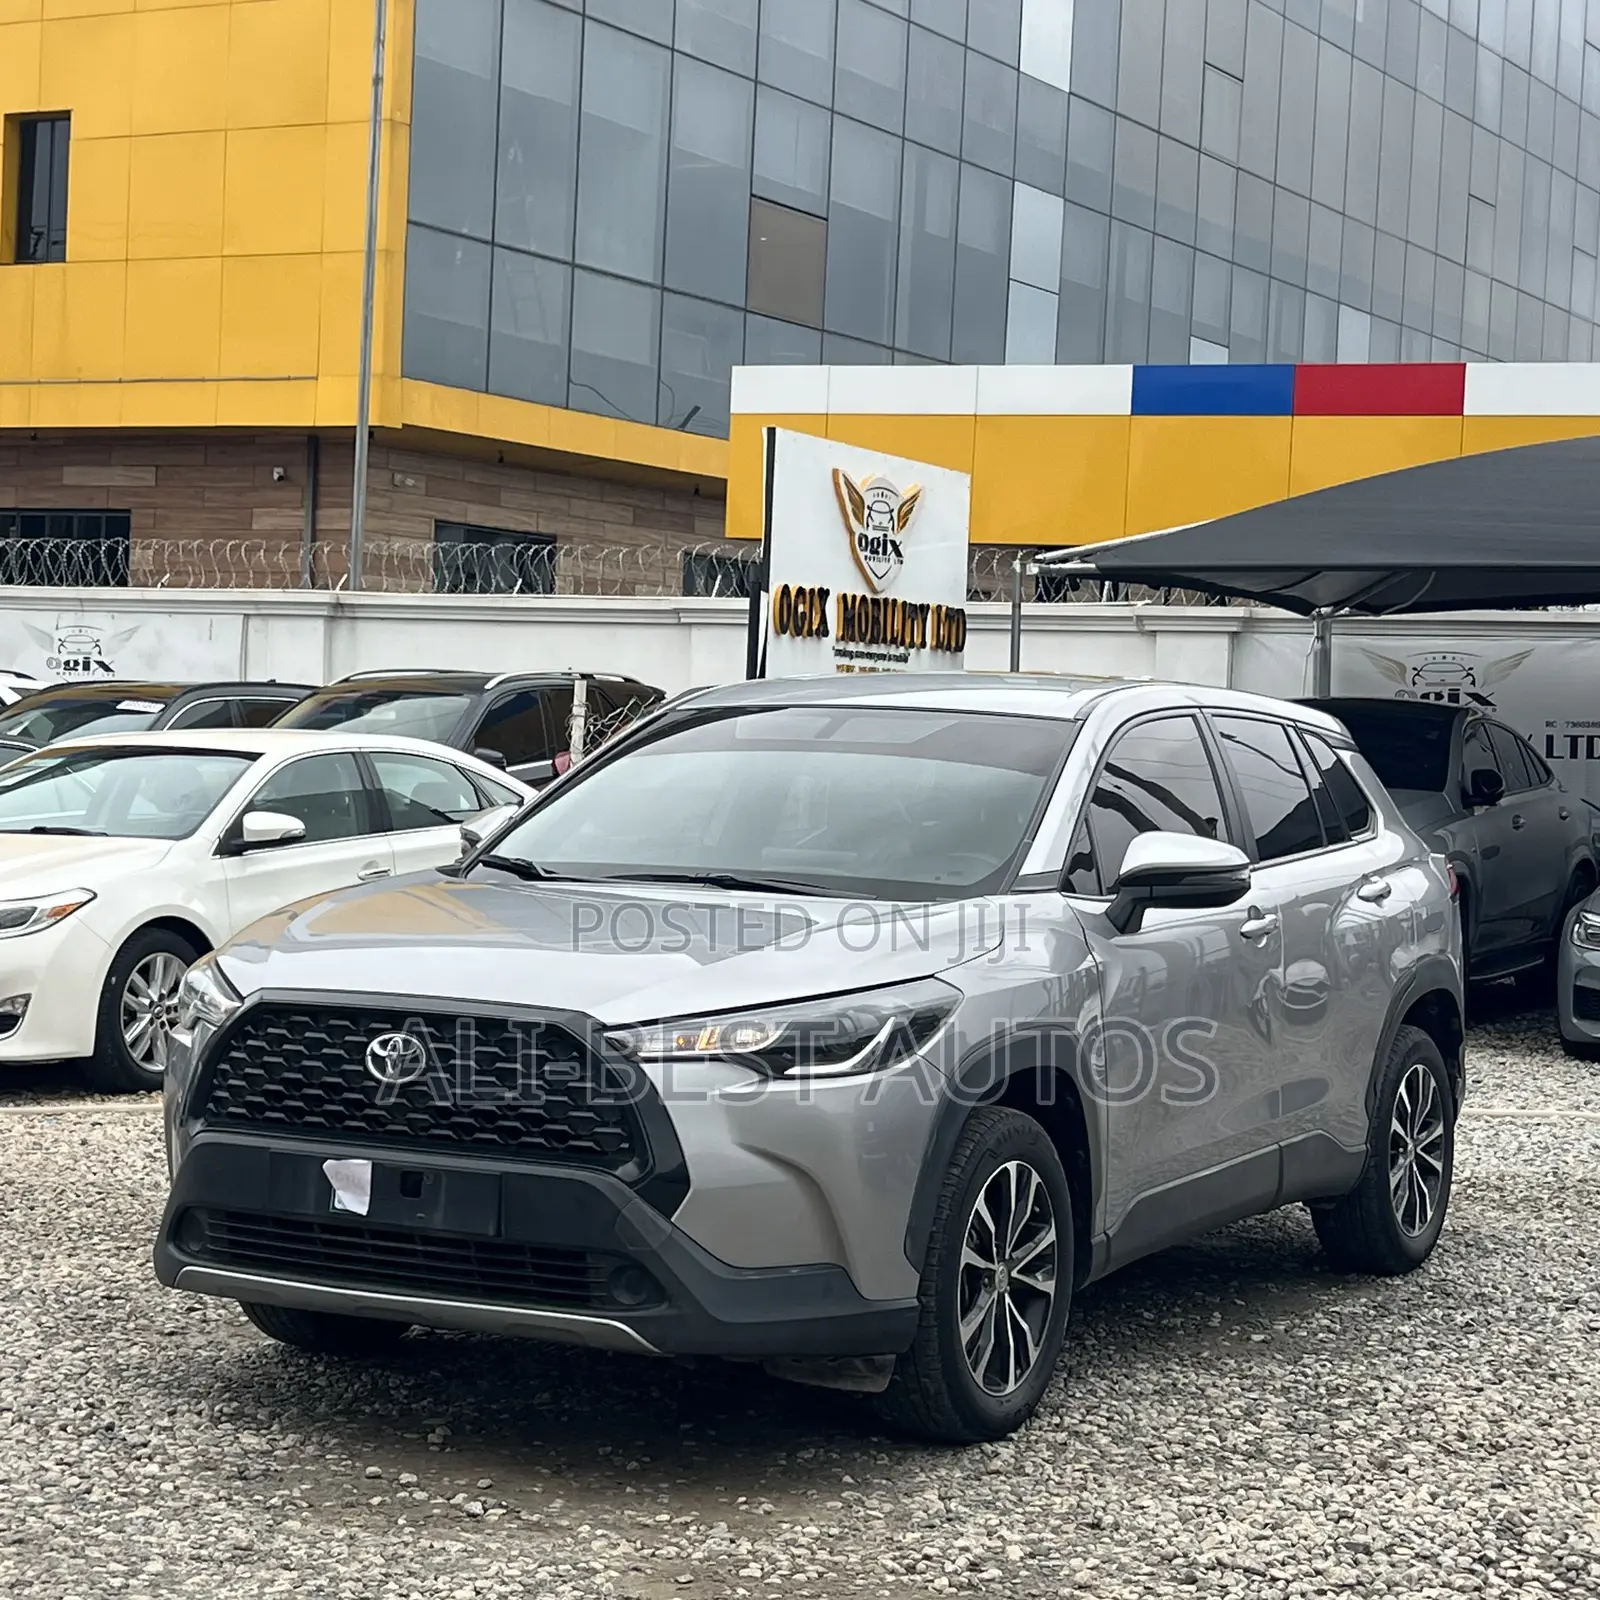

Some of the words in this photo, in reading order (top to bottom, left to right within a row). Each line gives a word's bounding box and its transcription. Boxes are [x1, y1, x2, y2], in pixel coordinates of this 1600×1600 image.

[773, 583, 831, 639] OGIX
[836, 592, 930, 650] MOBILITY
[930, 603, 967, 653] LTD
[1545, 734, 1600, 760] LTD
